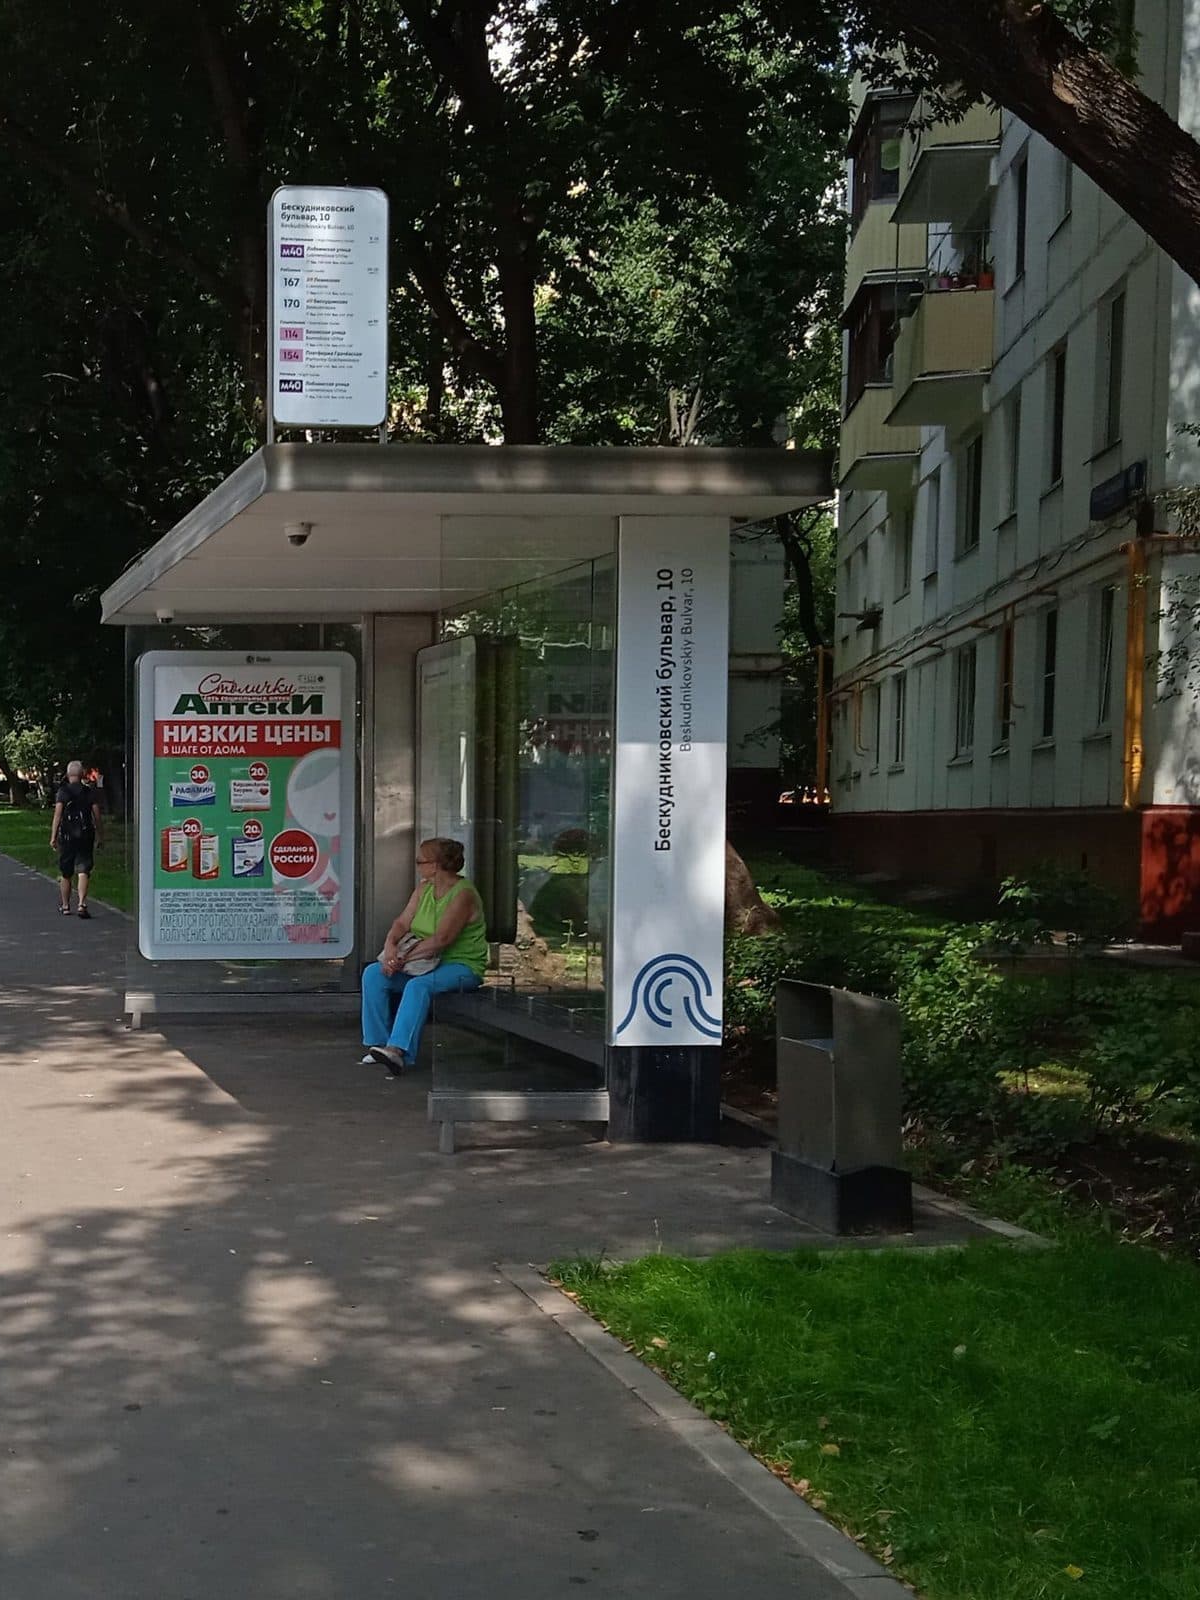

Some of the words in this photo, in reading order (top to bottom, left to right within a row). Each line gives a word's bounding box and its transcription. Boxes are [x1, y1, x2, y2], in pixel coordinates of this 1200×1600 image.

[281, 203, 355, 213] Бескудниковский
[281, 213, 318, 222] бульвар,
[320, 214, 331, 222] 10
[281, 247, 303, 257] м40
[284, 277, 300, 287] 167
[283, 299, 300, 308] 170
[284, 330, 298, 339] 114
[283, 351, 299, 360] 154
[280, 381, 302, 391] м40
[657, 568, 674, 591] 10
[680, 568, 693, 584] 10
[680, 588, 694, 635] Bulvar,
[656, 595, 677, 680] бульвар,
[680, 639, 694, 752] Beskudnikovskiy
[163, 725, 258, 743] НИЗКИЕ
[264, 725, 331, 746] ЦЕНЫ
[163, 746, 169, 754] В
[171, 746, 198, 754] ШАГЕ
[201, 746, 213, 754] ОТ
[214, 746, 246, 755] ДОМА
[655, 685, 675, 852] Бескудниковский
[175, 785, 214, 795] РАФАМИН
[273, 855, 314, 864] РОССИИ
